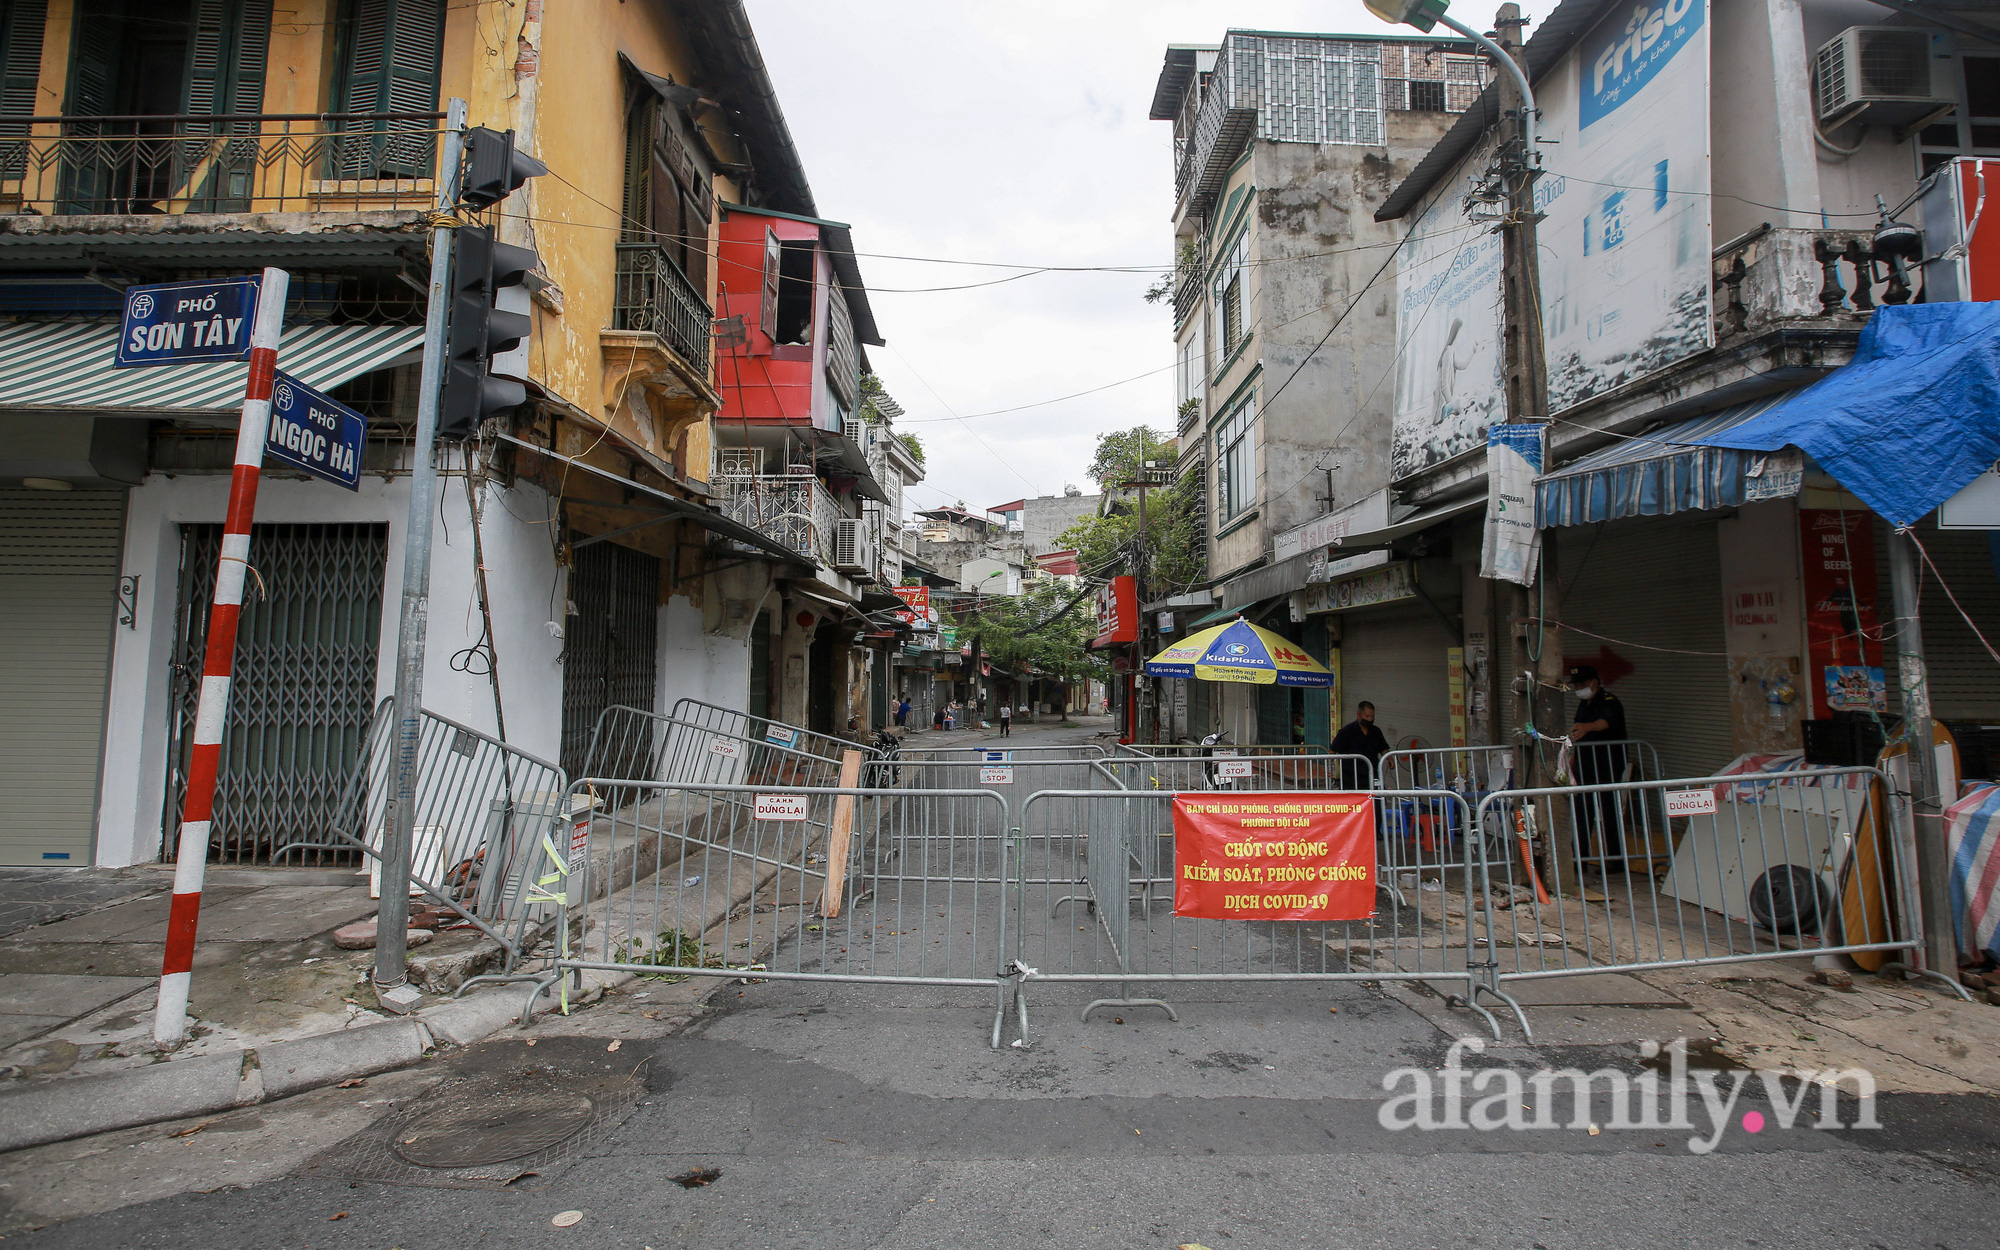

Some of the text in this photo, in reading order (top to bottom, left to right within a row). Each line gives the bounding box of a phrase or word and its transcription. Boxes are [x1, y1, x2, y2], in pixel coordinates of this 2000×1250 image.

[1593, 0, 1694, 97] Friso
[177, 291, 220, 313] PHỐ
[129, 313, 244, 353] SƠN TÂY
[308, 406, 338, 430] PHỐ
[270, 414, 354, 475] NGỌC HÀ
[1822, 547, 1835, 557] OF
[1823, 560, 1853, 570] BEERS
[771, 730, 788, 738] STOP
[714, 745, 734, 754] STOP
[758, 803, 804, 816] DỪNG LẠI
[1186, 802, 1362, 816] BAN CHỈ ĐẠO PHÒNG, CHỐNG DỊCH COVID-19
[1669, 800, 1713, 810] DỪNG LẠI
[1241, 816, 1275, 828] PHƯỜNG
[1276, 816, 1291, 829] ĐỘI
[1224, 836, 1329, 860] CHỐT CƠ ĐỘNG
[1183, 860, 1367, 884] KIỂM SOÁT, PHÒNG CHỐNG
[1224, 894, 1329, 912] DỊCH COVID-19
